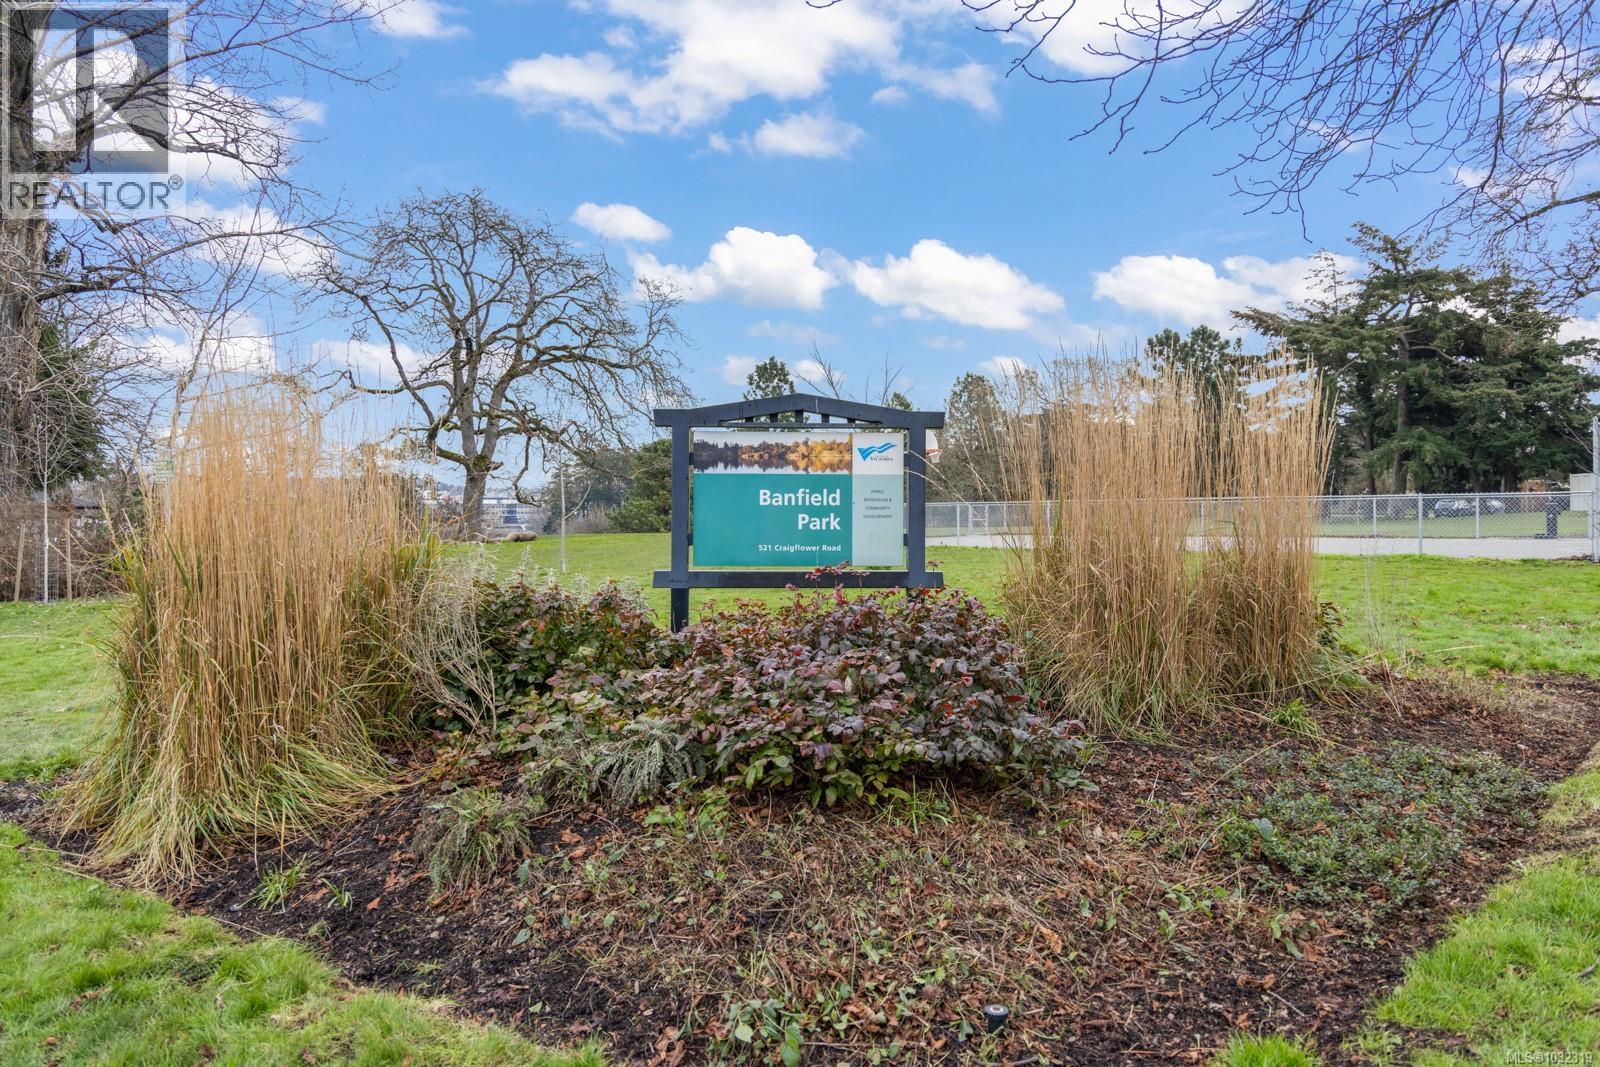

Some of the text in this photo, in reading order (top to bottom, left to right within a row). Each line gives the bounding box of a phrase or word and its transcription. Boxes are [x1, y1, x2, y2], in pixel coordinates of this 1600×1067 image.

[759, 488, 841, 506] Banfield
[797, 513, 841, 530] Park
[774, 544, 820, 553] Craigflower
